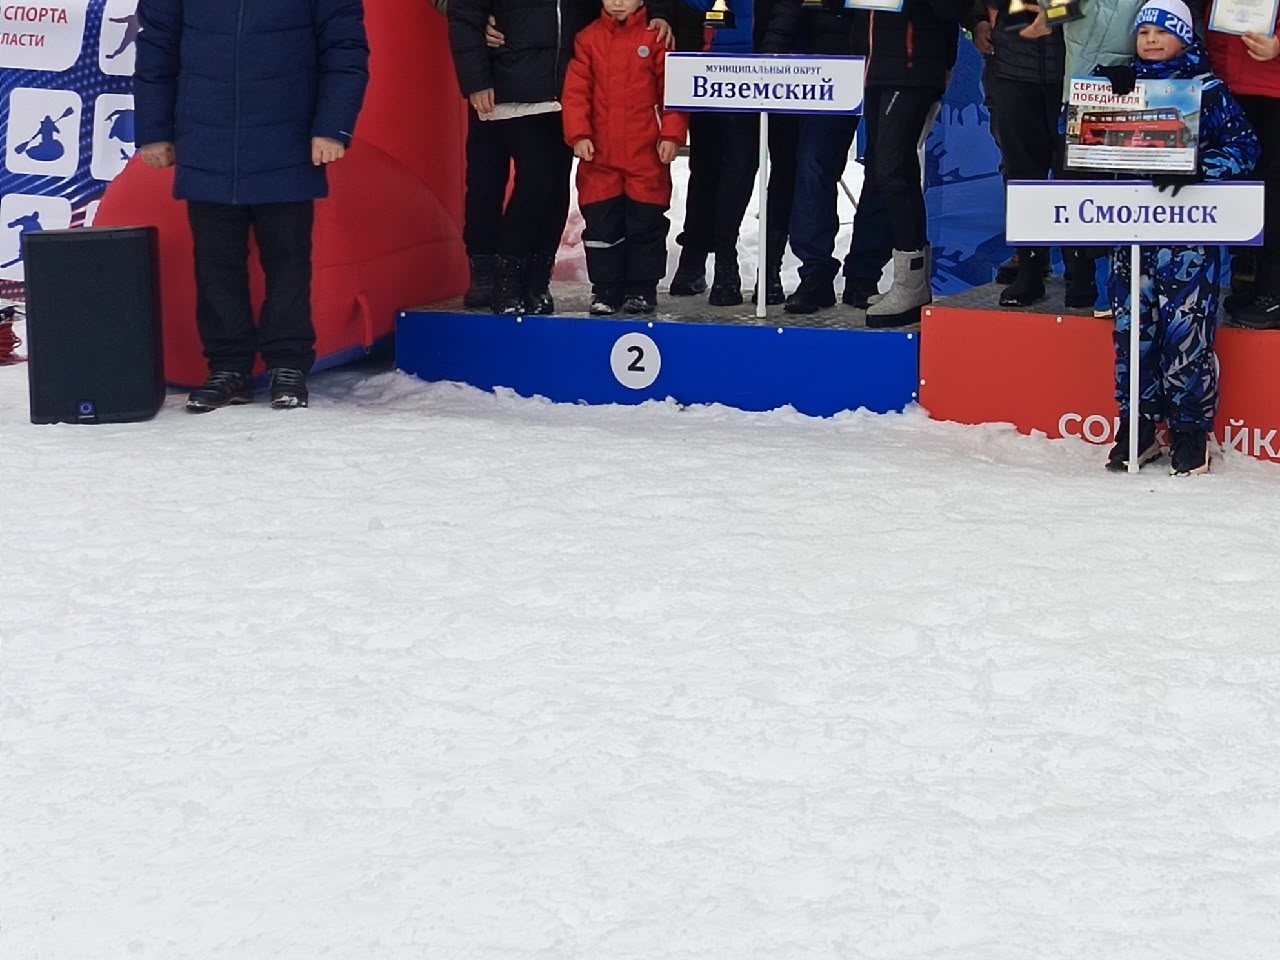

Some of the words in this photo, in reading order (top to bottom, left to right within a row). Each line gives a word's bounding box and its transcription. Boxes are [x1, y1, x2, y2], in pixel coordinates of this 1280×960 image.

[4, 6, 68, 24] СПОРТА
[0, 32, 46, 47] ЛАСТИ
[1165, 13, 1194, 45] 202
[706, 64, 793, 75] МУНИЦИПАЛЬНЫЙ
[794, 66, 822, 76] ОКРУГ
[692, 75, 835, 101] Вяземский
[1073, 93, 1141, 105] ПОБЕДИТЕЛЯ
[1053, 205, 1069, 224] г.
[1078, 198, 1218, 224] Смоленск
[627, 345, 645, 372] 2
